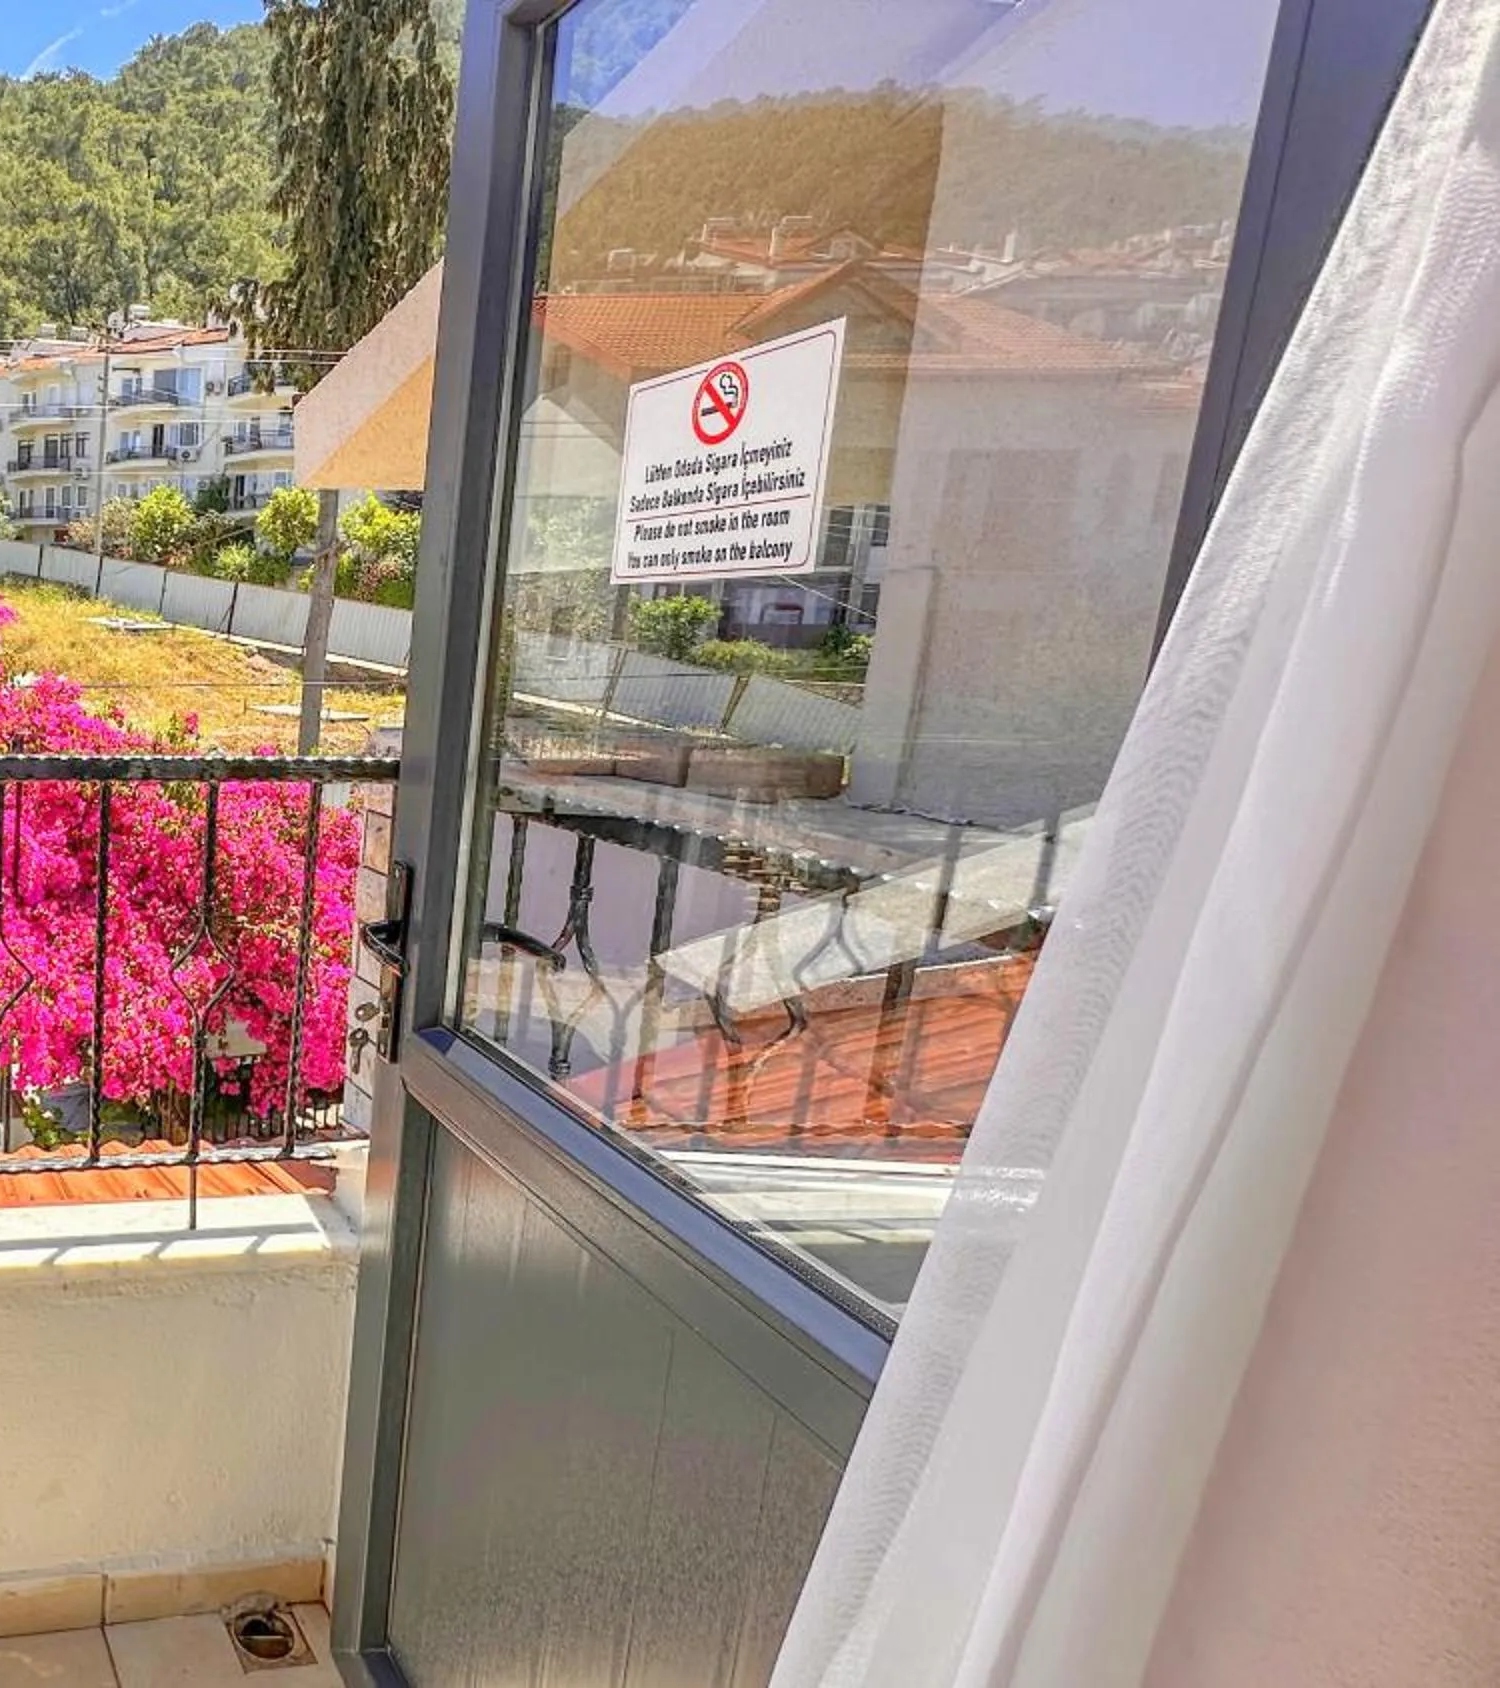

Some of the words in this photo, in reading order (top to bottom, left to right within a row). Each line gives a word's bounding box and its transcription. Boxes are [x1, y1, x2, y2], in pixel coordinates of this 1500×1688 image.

[645, 463, 672, 484] Lütfen
[674, 455, 703, 478] Odada
[705, 452, 738, 475] Sigara
[740, 437, 793, 471] İçmeyiniz
[630, 493, 660, 512] Sadece
[705, 481, 739, 505] Sigara
[740, 467, 805, 500] İçebilirsiniz
[633, 524, 663, 542] Please
[664, 520, 676, 538] do
[678, 518, 692, 537] not
[694, 513, 727, 535] smoke
[728, 512, 739, 531] in
[741, 509, 759, 529] the
[761, 509, 790, 527] room
[627, 551, 640, 569] You
[643, 553, 658, 568] can
[660, 548, 681, 570] only
[681, 544, 712, 565] smoke
[715, 547, 727, 563] on
[729, 541, 747, 561] the
[749, 538, 793, 563] balcony
